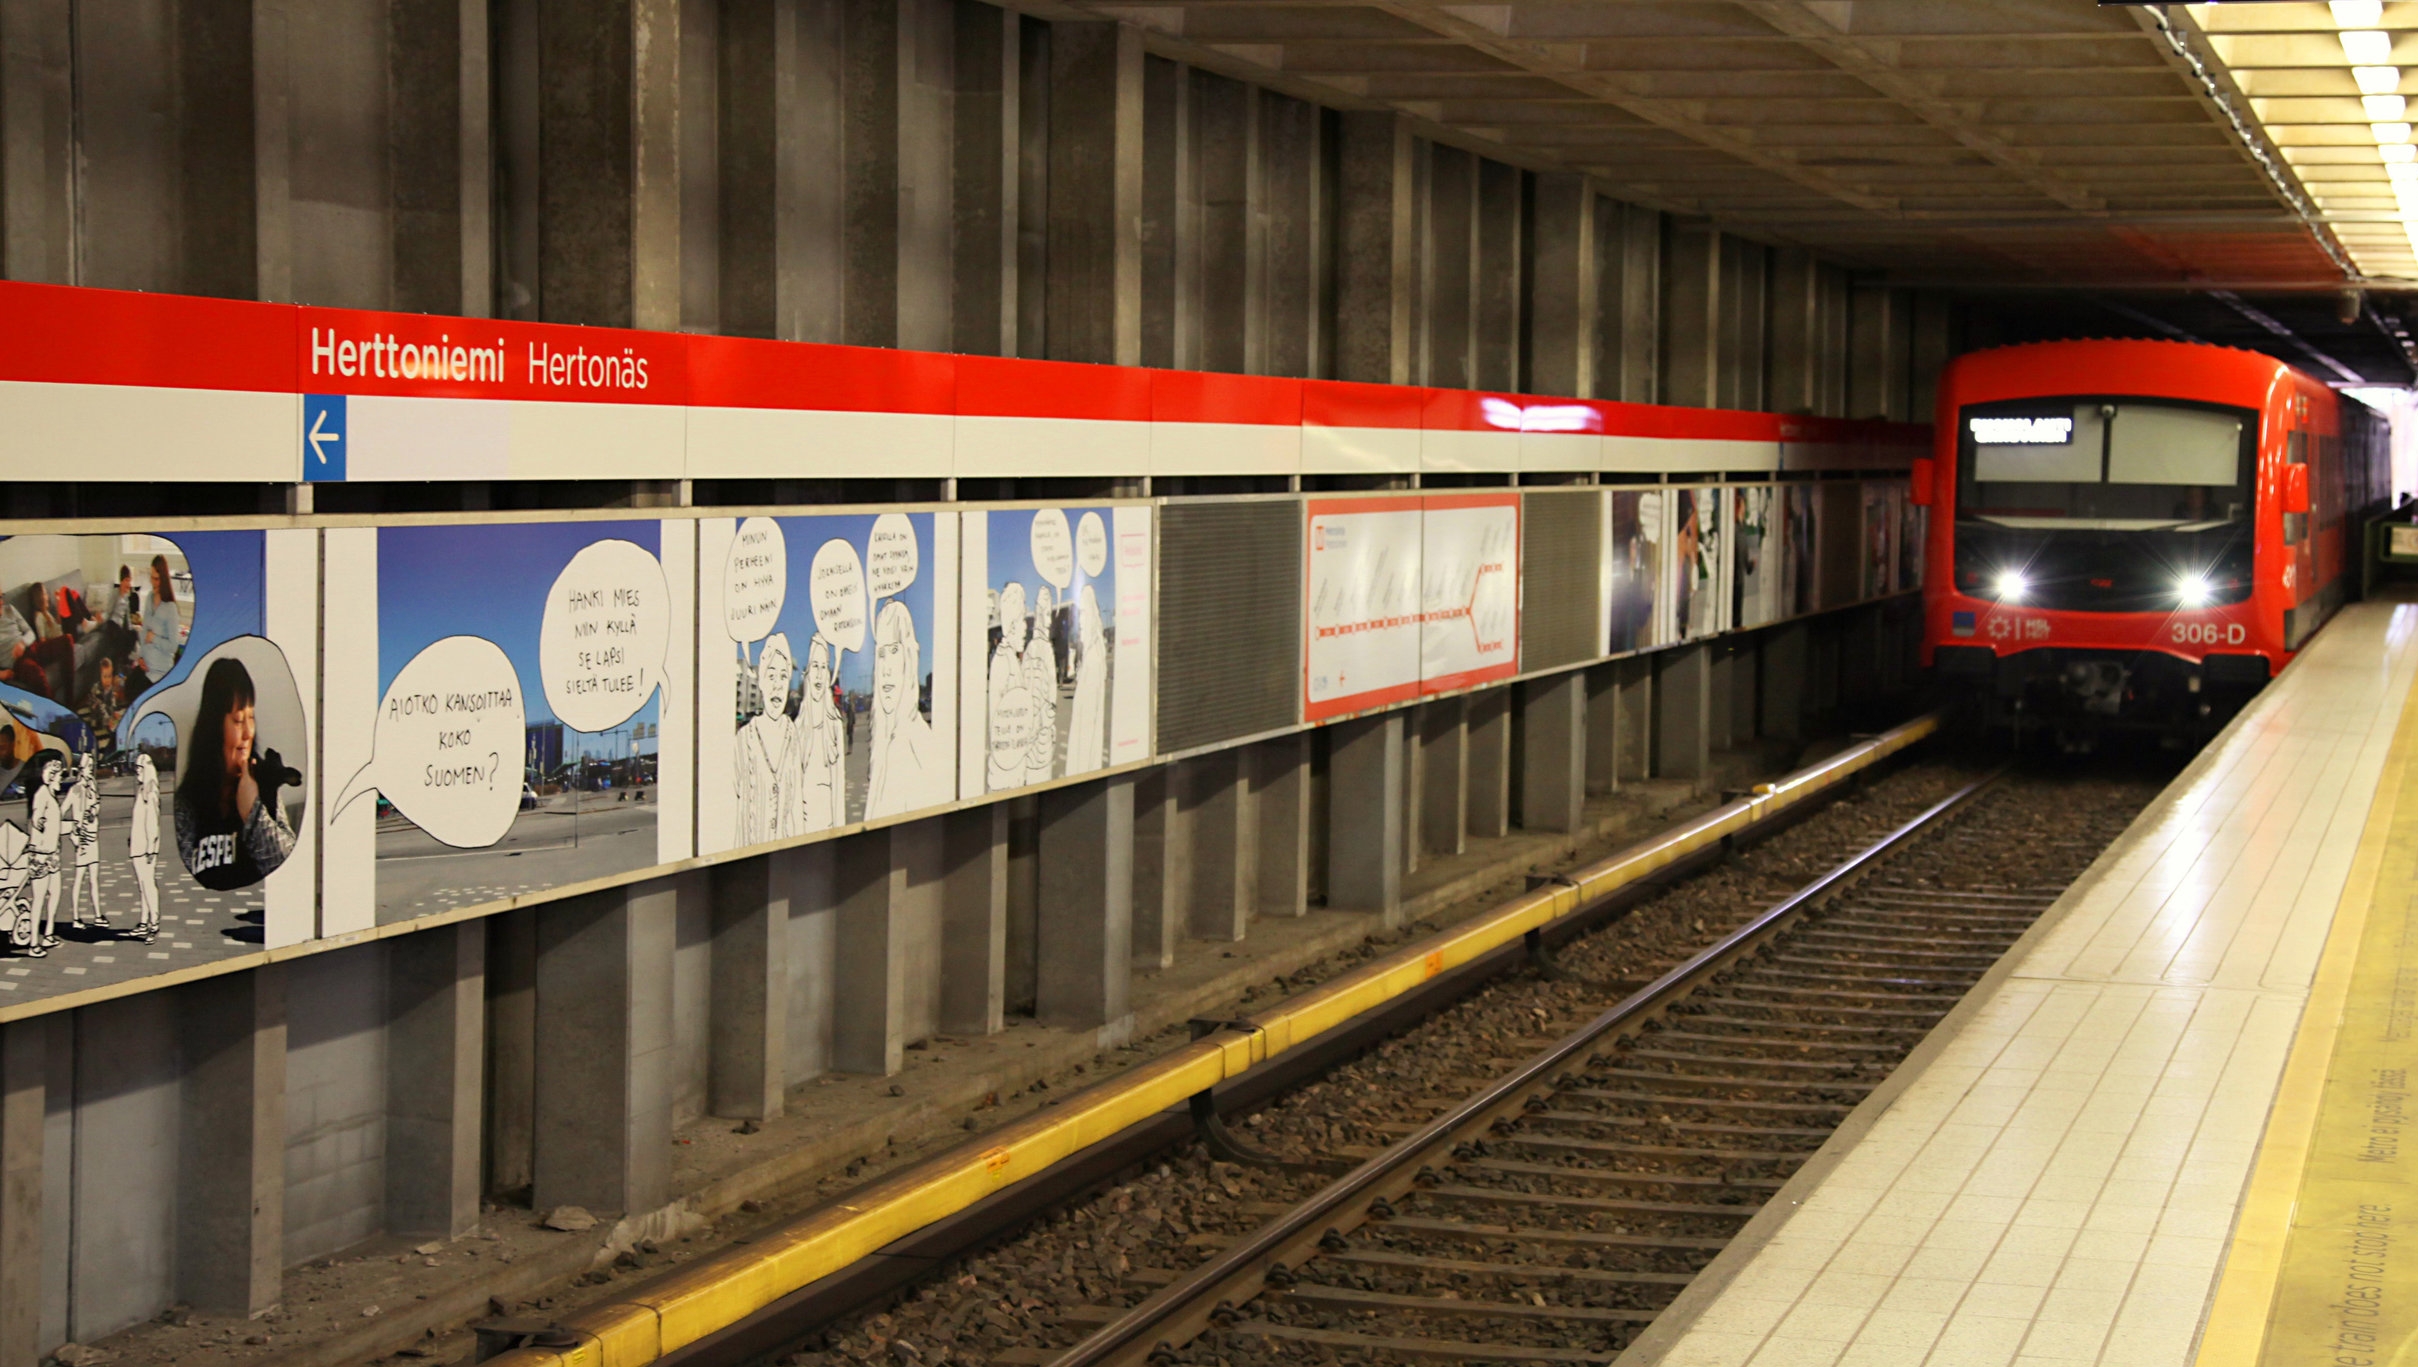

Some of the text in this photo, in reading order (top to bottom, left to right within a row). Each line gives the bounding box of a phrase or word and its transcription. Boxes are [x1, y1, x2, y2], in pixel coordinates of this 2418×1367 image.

[311, 326, 649, 390] Herttoniemi Hertonäs
[568, 588, 640, 613] HANKI MIES
[2171, 622, 2246, 645] 306-D
[578, 646, 626, 670] SE LAPSI
[388, 688, 513, 722] AIOTKO KANSOITTAA
[438, 728, 472, 751] KOKO
[2356, 1135, 2399, 1164] Metro
[2343, 1230, 2398, 1258] stop
[2341, 1259, 2385, 1283] not
[2328, 1284, 2383, 1317] does
[2326, 1319, 2376, 1353] train
